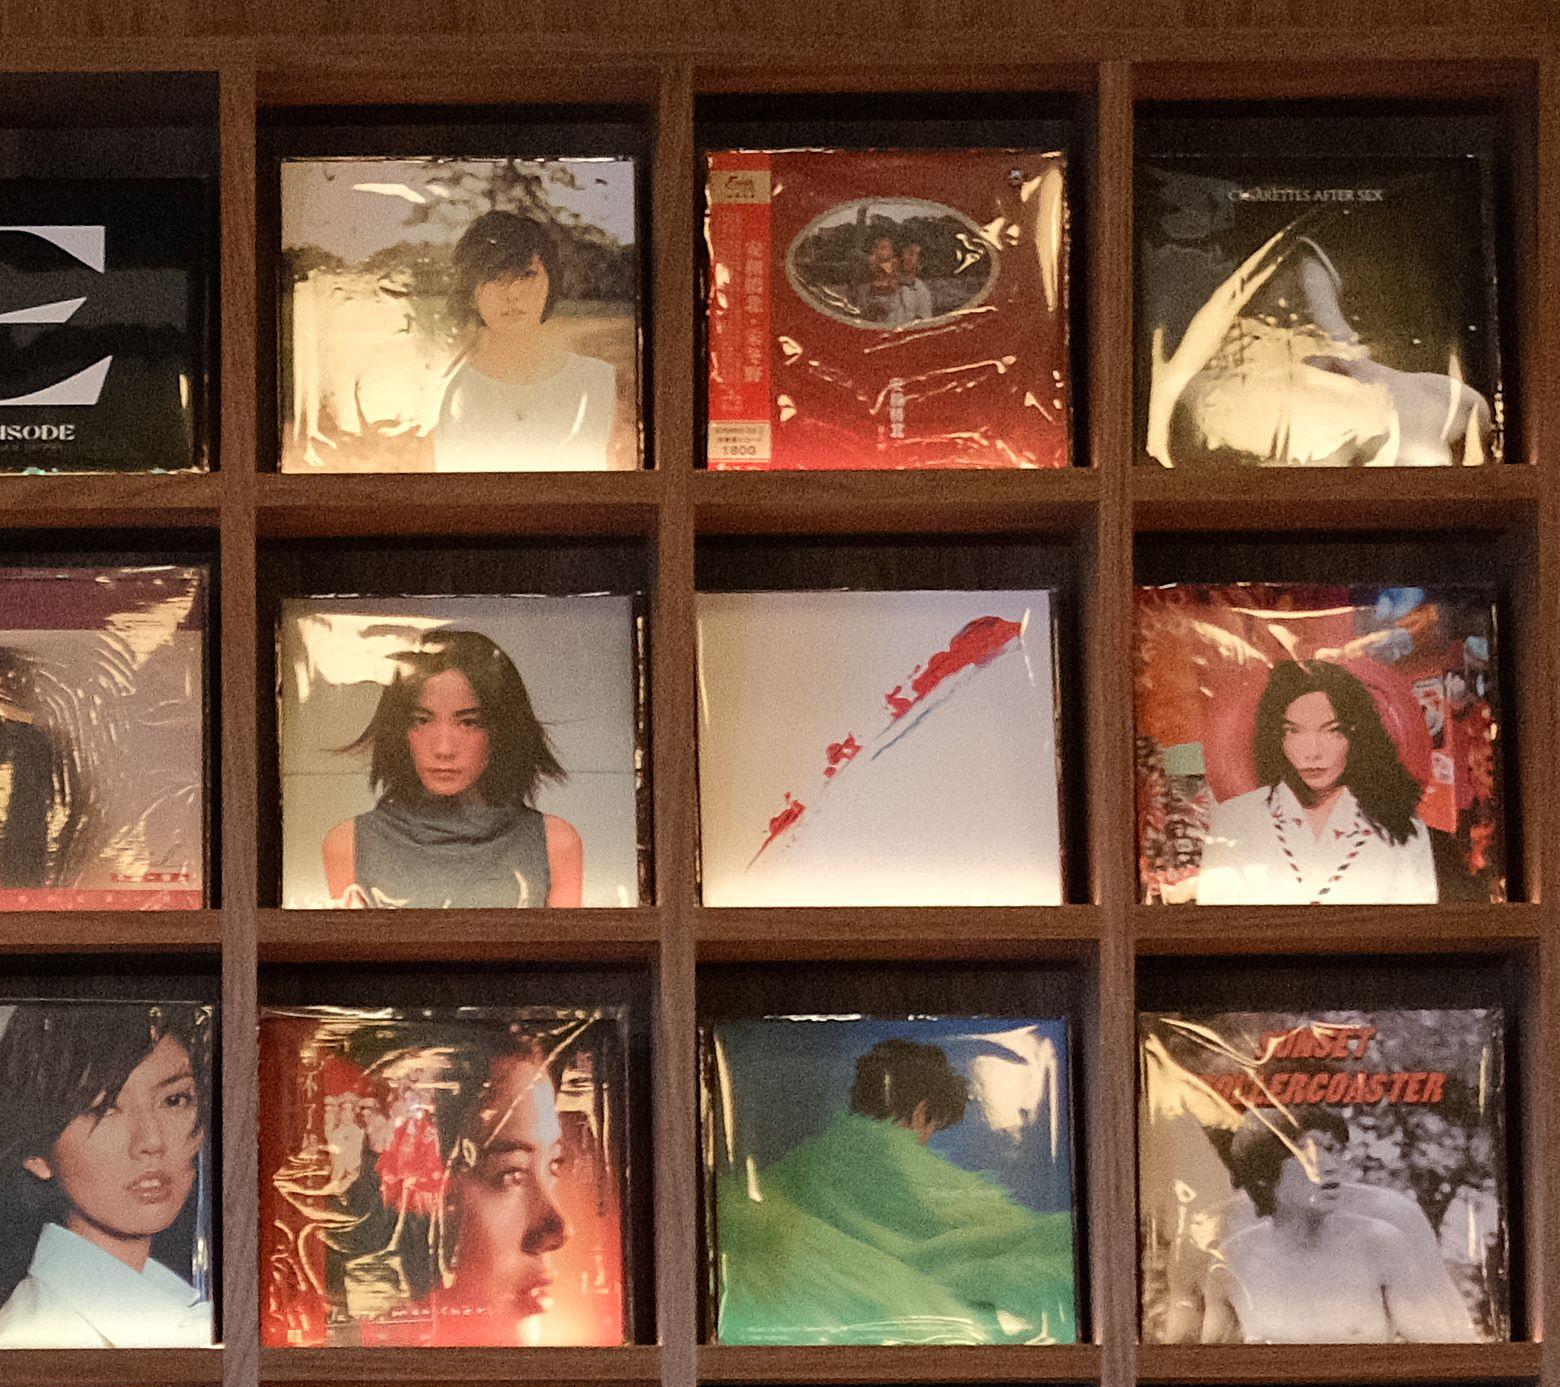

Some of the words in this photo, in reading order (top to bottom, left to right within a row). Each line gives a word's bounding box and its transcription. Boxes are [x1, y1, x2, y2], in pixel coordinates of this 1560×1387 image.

[1313, 189, 1355, 202] AFTER
[1358, 189, 1384, 202] SEX
[1255, 1026, 1377, 1062] SUNSET
